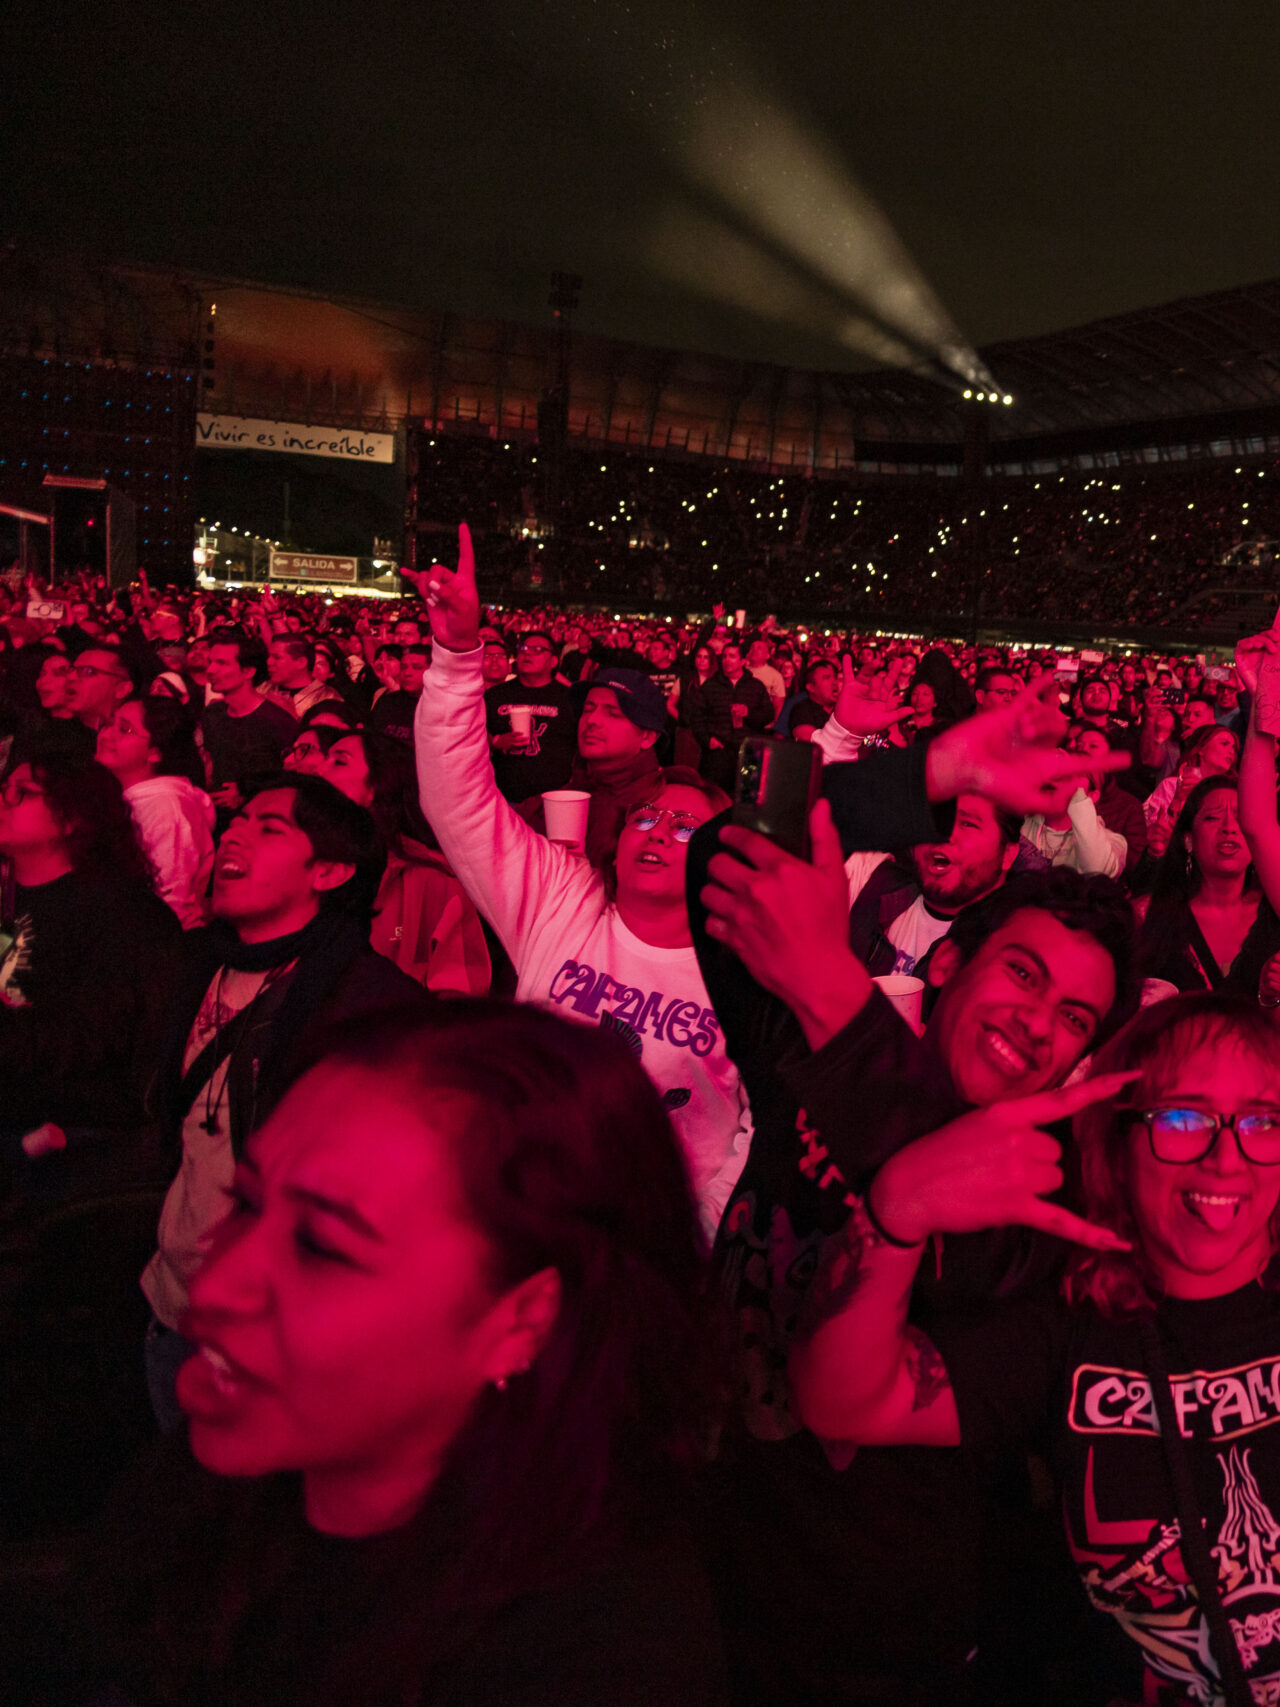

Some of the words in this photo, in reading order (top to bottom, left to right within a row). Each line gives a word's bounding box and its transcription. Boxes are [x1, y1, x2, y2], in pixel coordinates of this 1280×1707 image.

[196, 421, 249, 442] Vivir
[257, 433, 274, 446] es
[293, 558, 335, 570] SALIDA
